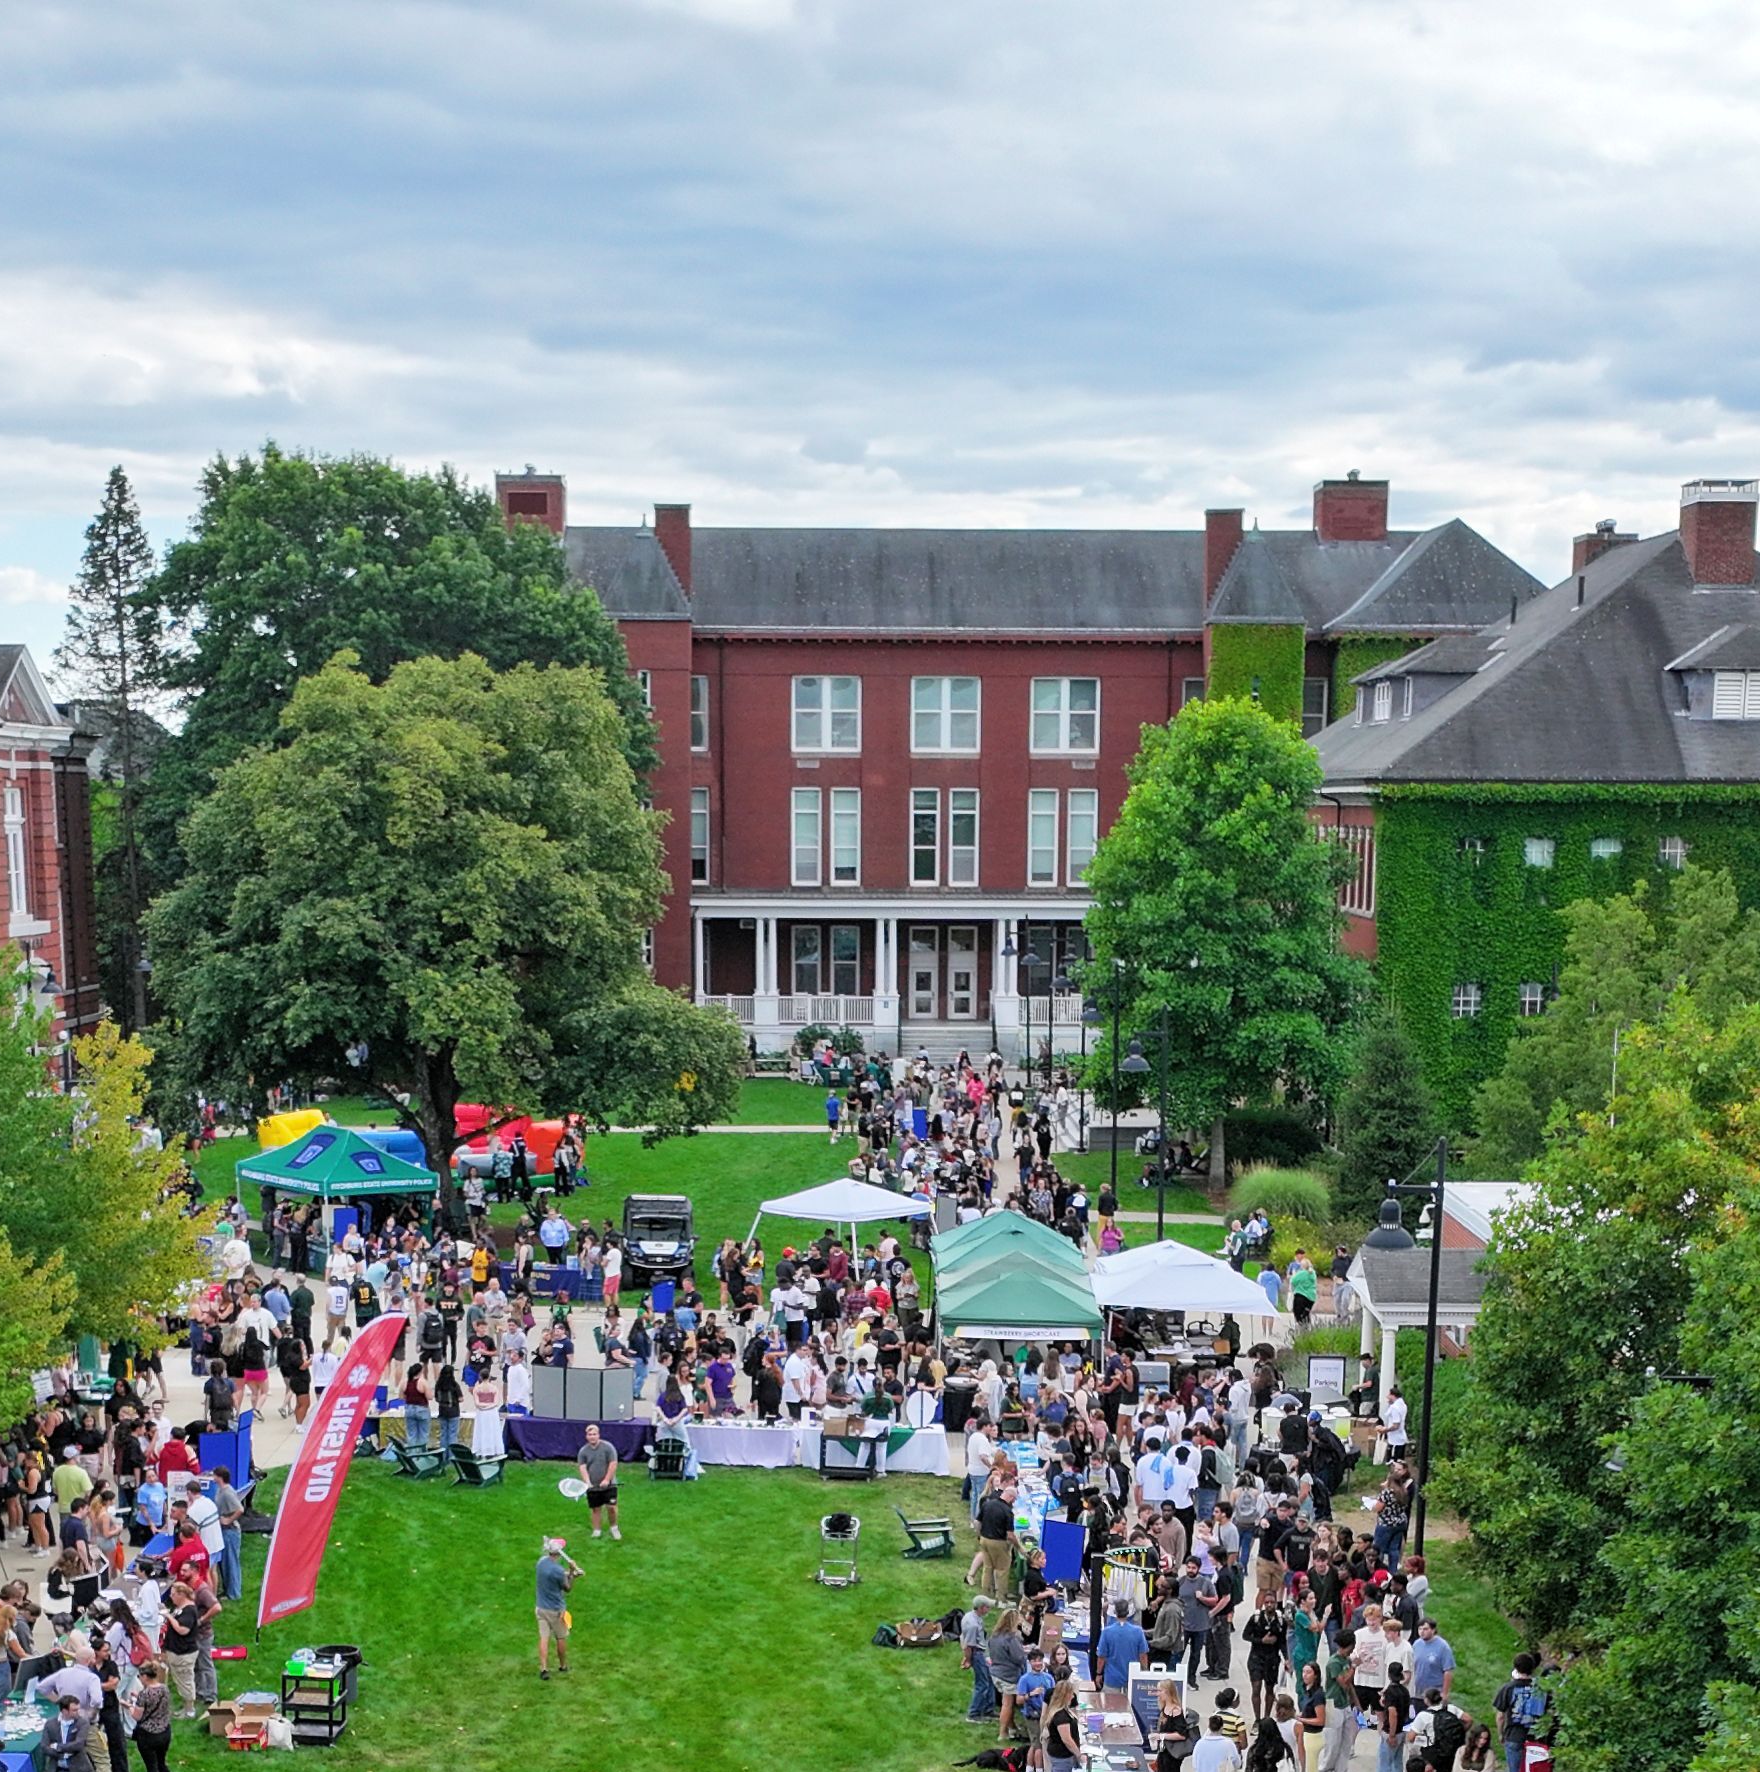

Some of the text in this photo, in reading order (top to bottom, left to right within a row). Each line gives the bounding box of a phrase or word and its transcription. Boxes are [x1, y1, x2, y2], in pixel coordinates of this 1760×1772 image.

[984, 1329, 1060, 1338] STRAWBERRY SHORTCAKE
[1314, 1379, 1338, 1388] Parking
